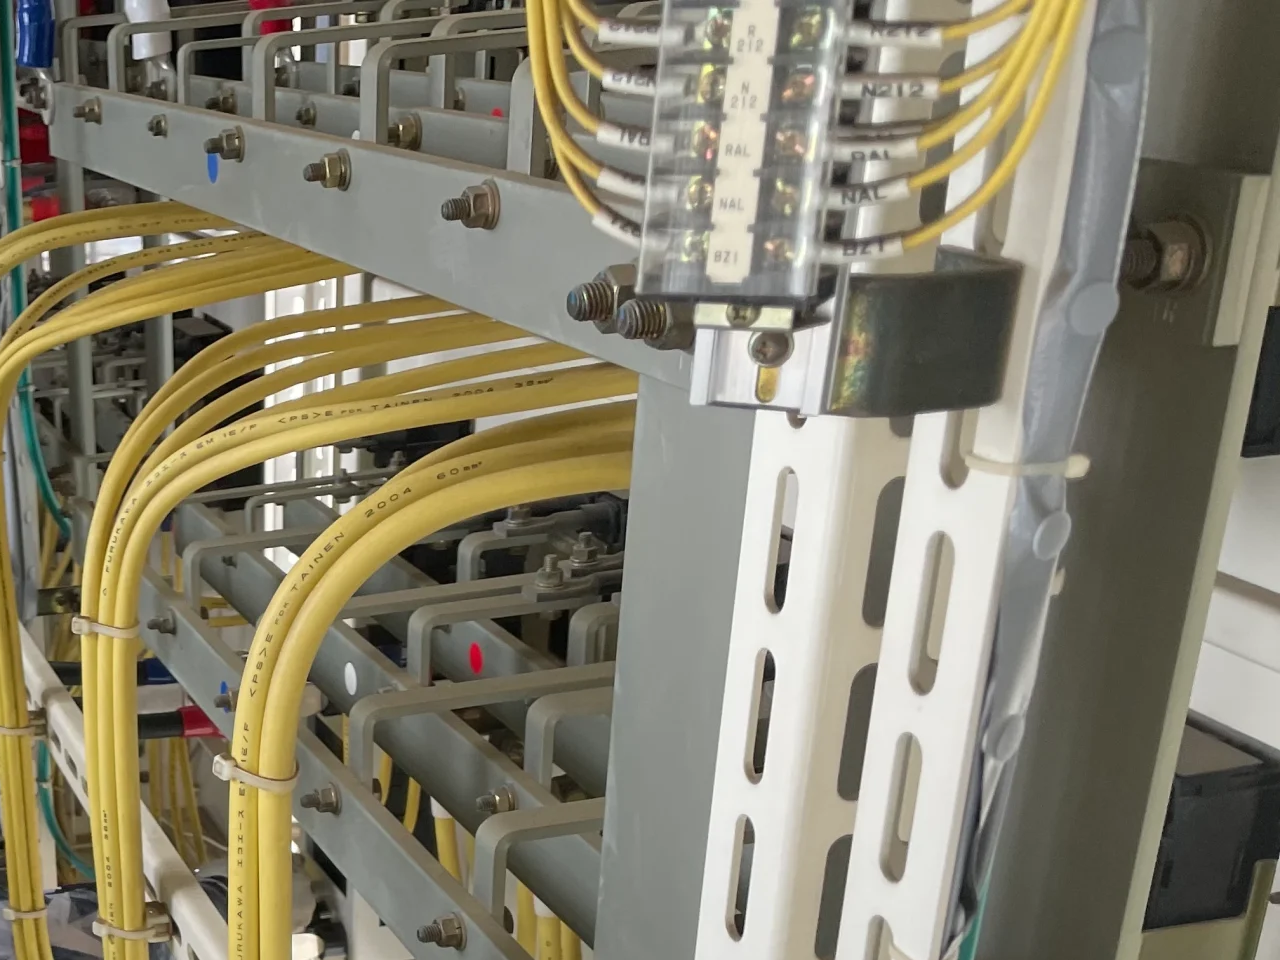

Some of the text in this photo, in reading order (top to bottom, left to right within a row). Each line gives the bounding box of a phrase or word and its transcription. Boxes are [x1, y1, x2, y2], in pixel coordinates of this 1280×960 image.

[748, 25, 756, 38] R
[736, 39, 765, 52] 212
[741, 82, 750, 93] N
[861, 81, 925, 99] N212
[730, 95, 759, 109] 212
[724, 143, 752, 158] RAL
[841, 187, 888, 205] NAL
[719, 197, 746, 212] NAL
[103, 495, 138, 573] FURUKAWA
[194, 436, 215, 450] EM
[221, 422, 258, 439] IE/F
[369, 396, 433, 410] TAINEN
[239, 721, 251, 763] IE/F
[247, 631, 275, 698] <PS>E
[289, 529, 346, 595] TAINEN
[362, 485, 414, 519] 2004
